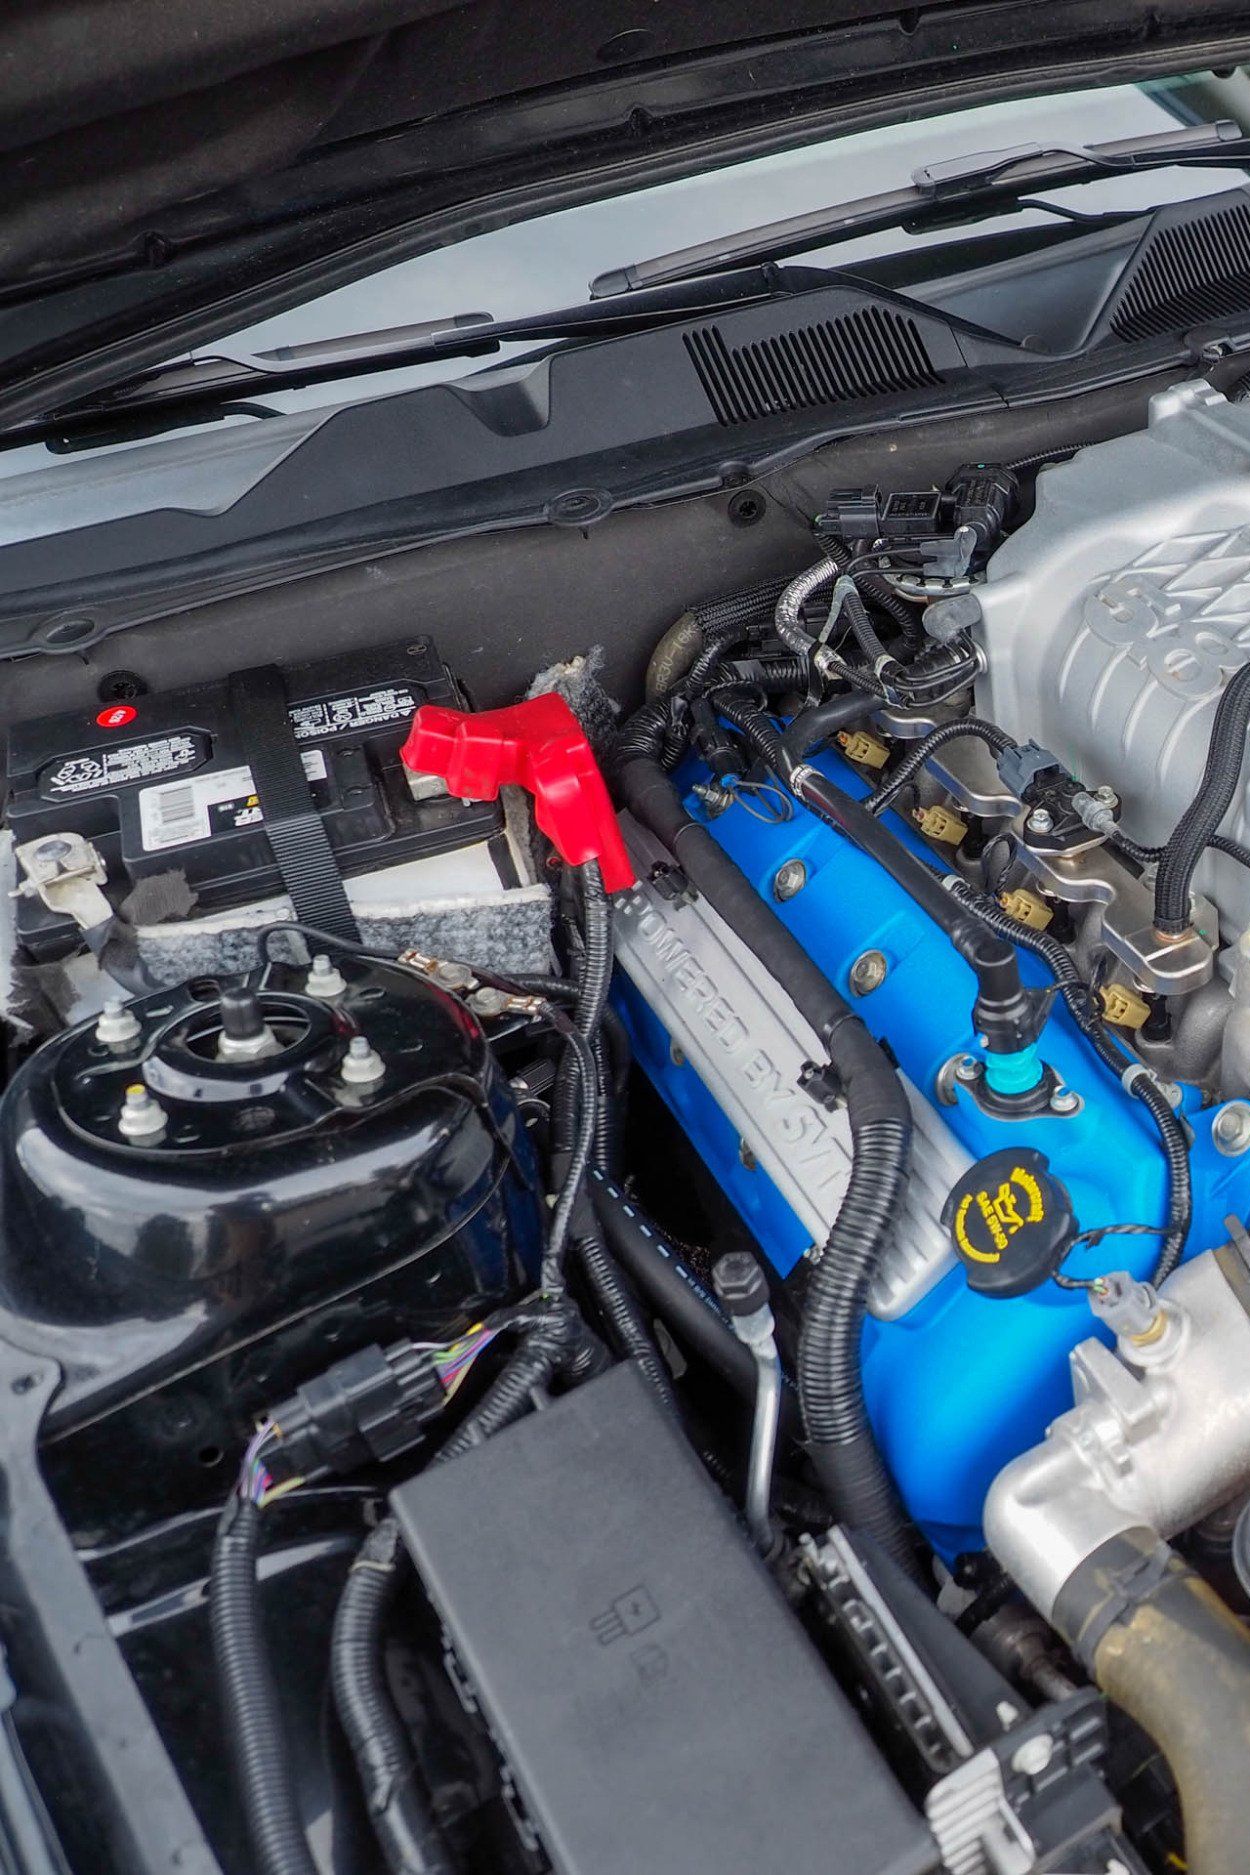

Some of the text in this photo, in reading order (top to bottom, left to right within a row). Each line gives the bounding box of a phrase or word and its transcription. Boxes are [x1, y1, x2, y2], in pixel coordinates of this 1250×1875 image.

[350, 712, 399, 728] DANGER
[744, 1047, 796, 1097] BY
[976, 1191, 994, 1218] SAE
